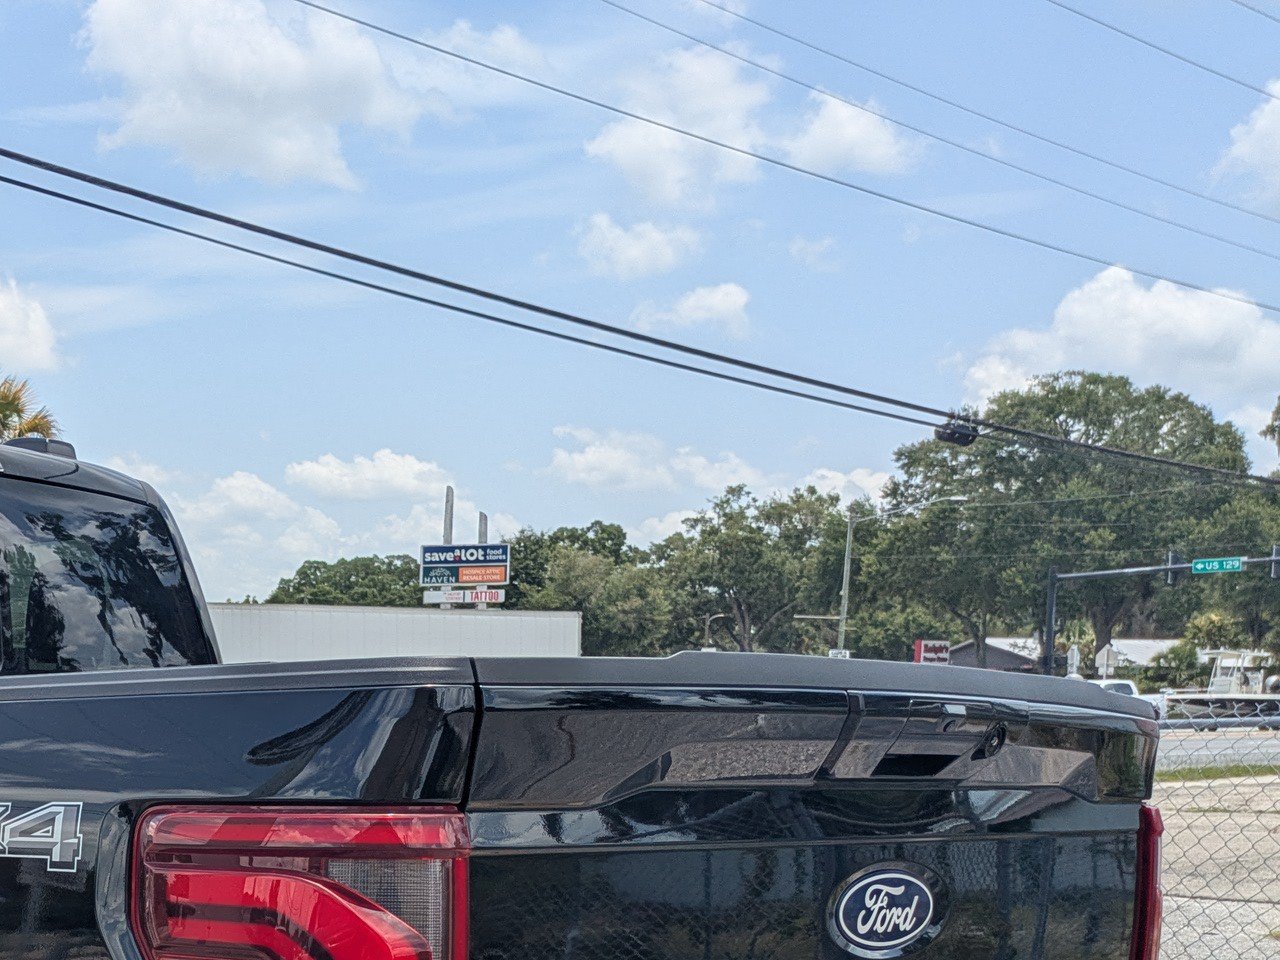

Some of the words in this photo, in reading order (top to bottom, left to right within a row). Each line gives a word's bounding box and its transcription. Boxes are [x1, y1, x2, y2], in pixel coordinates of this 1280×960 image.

[424, 552, 454, 562] save
[1205, 561, 1219, 570] US
[1222, 560, 1239, 569] 129
[470, 591, 499, 602] TATTOO
[856, 884, 920, 935] Ford
